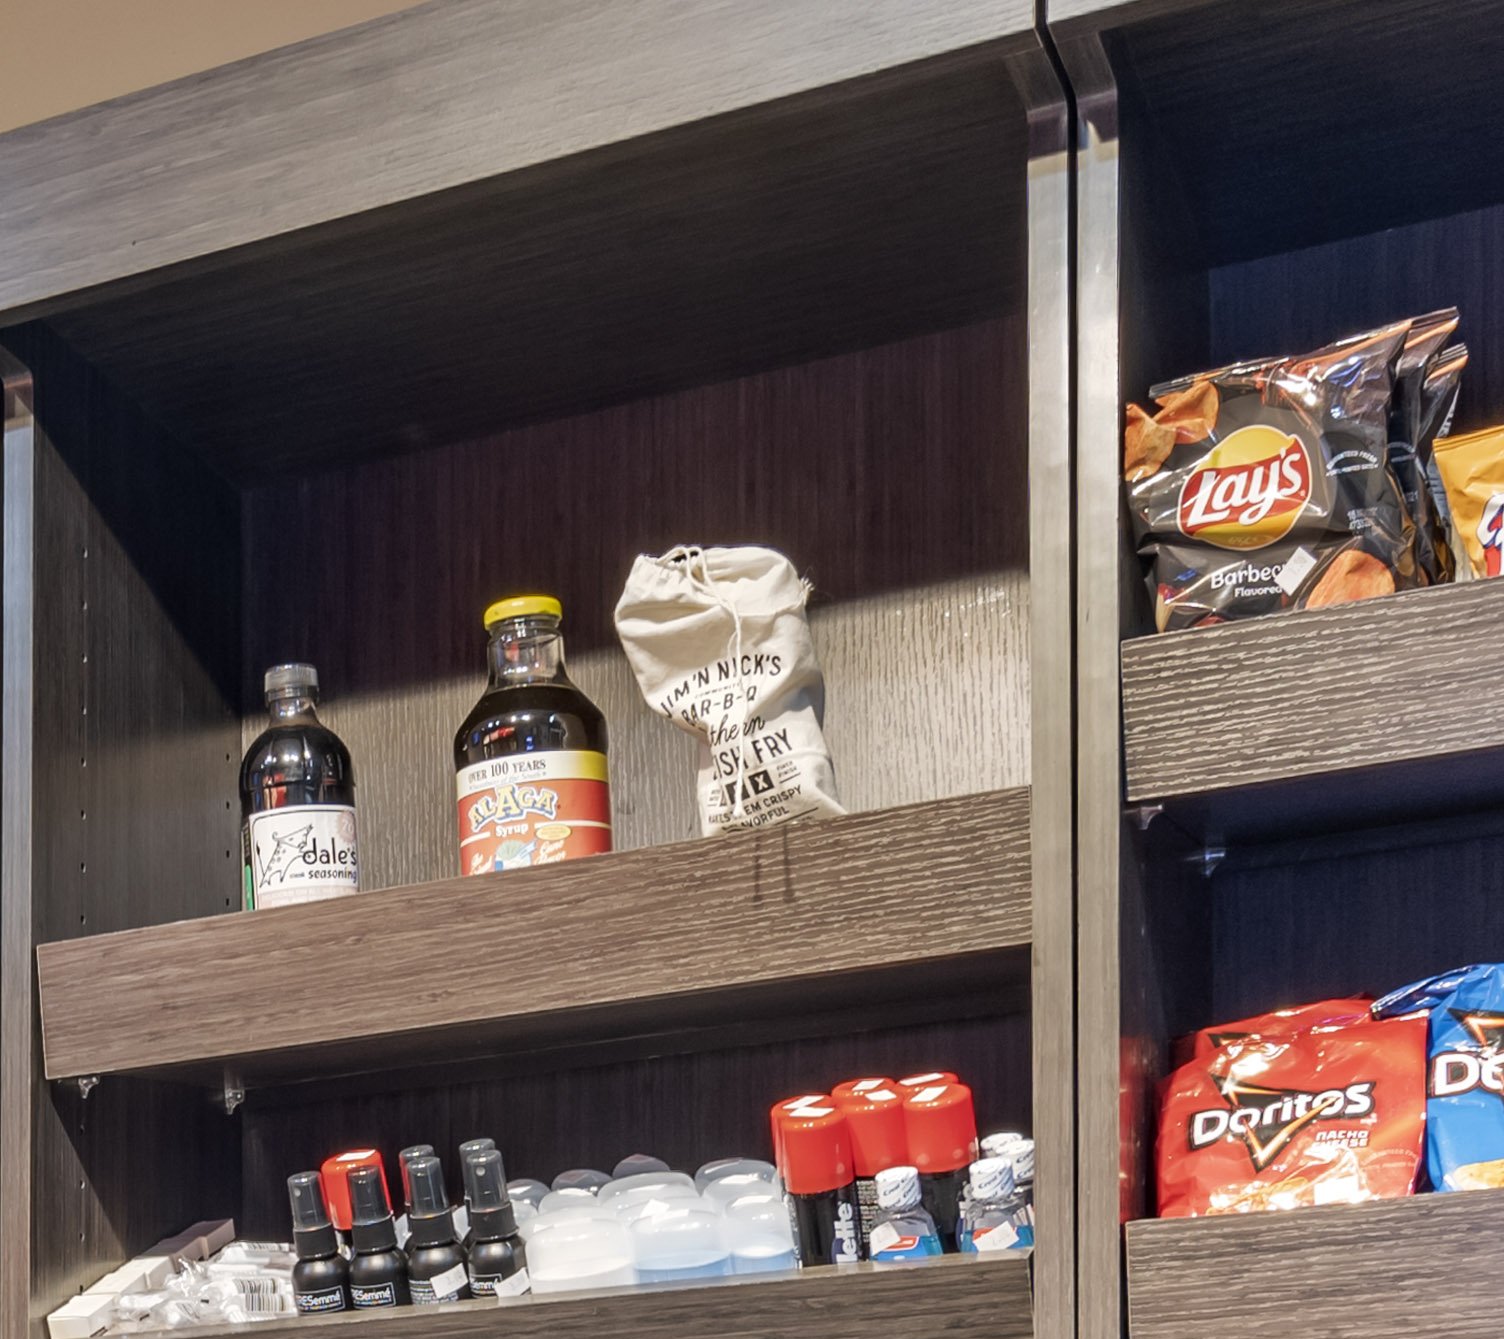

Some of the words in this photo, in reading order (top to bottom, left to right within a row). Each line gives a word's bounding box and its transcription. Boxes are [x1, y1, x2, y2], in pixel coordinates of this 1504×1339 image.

[1180, 445, 1306, 530] Lay's
[1210, 558, 1284, 589] Barbec
[661, 667, 709, 718] JIM'N
[718, 654, 782, 681] NICK'S
[751, 728, 794, 764] FRY
[468, 769, 487, 784] OVER
[491, 761, 509, 777] 100
[512, 758, 546, 774] YEARS
[468, 784, 558, 832] ALAGA
[763, 785, 802, 807] CRISPY
[496, 823, 529, 837] Syrup
[303, 837, 357, 866] dale's
[308, 868, 357, 884] seasoning
[1190, 1080, 1376, 1152] Doritos
[1315, 1129, 1368, 1141] NACHO
